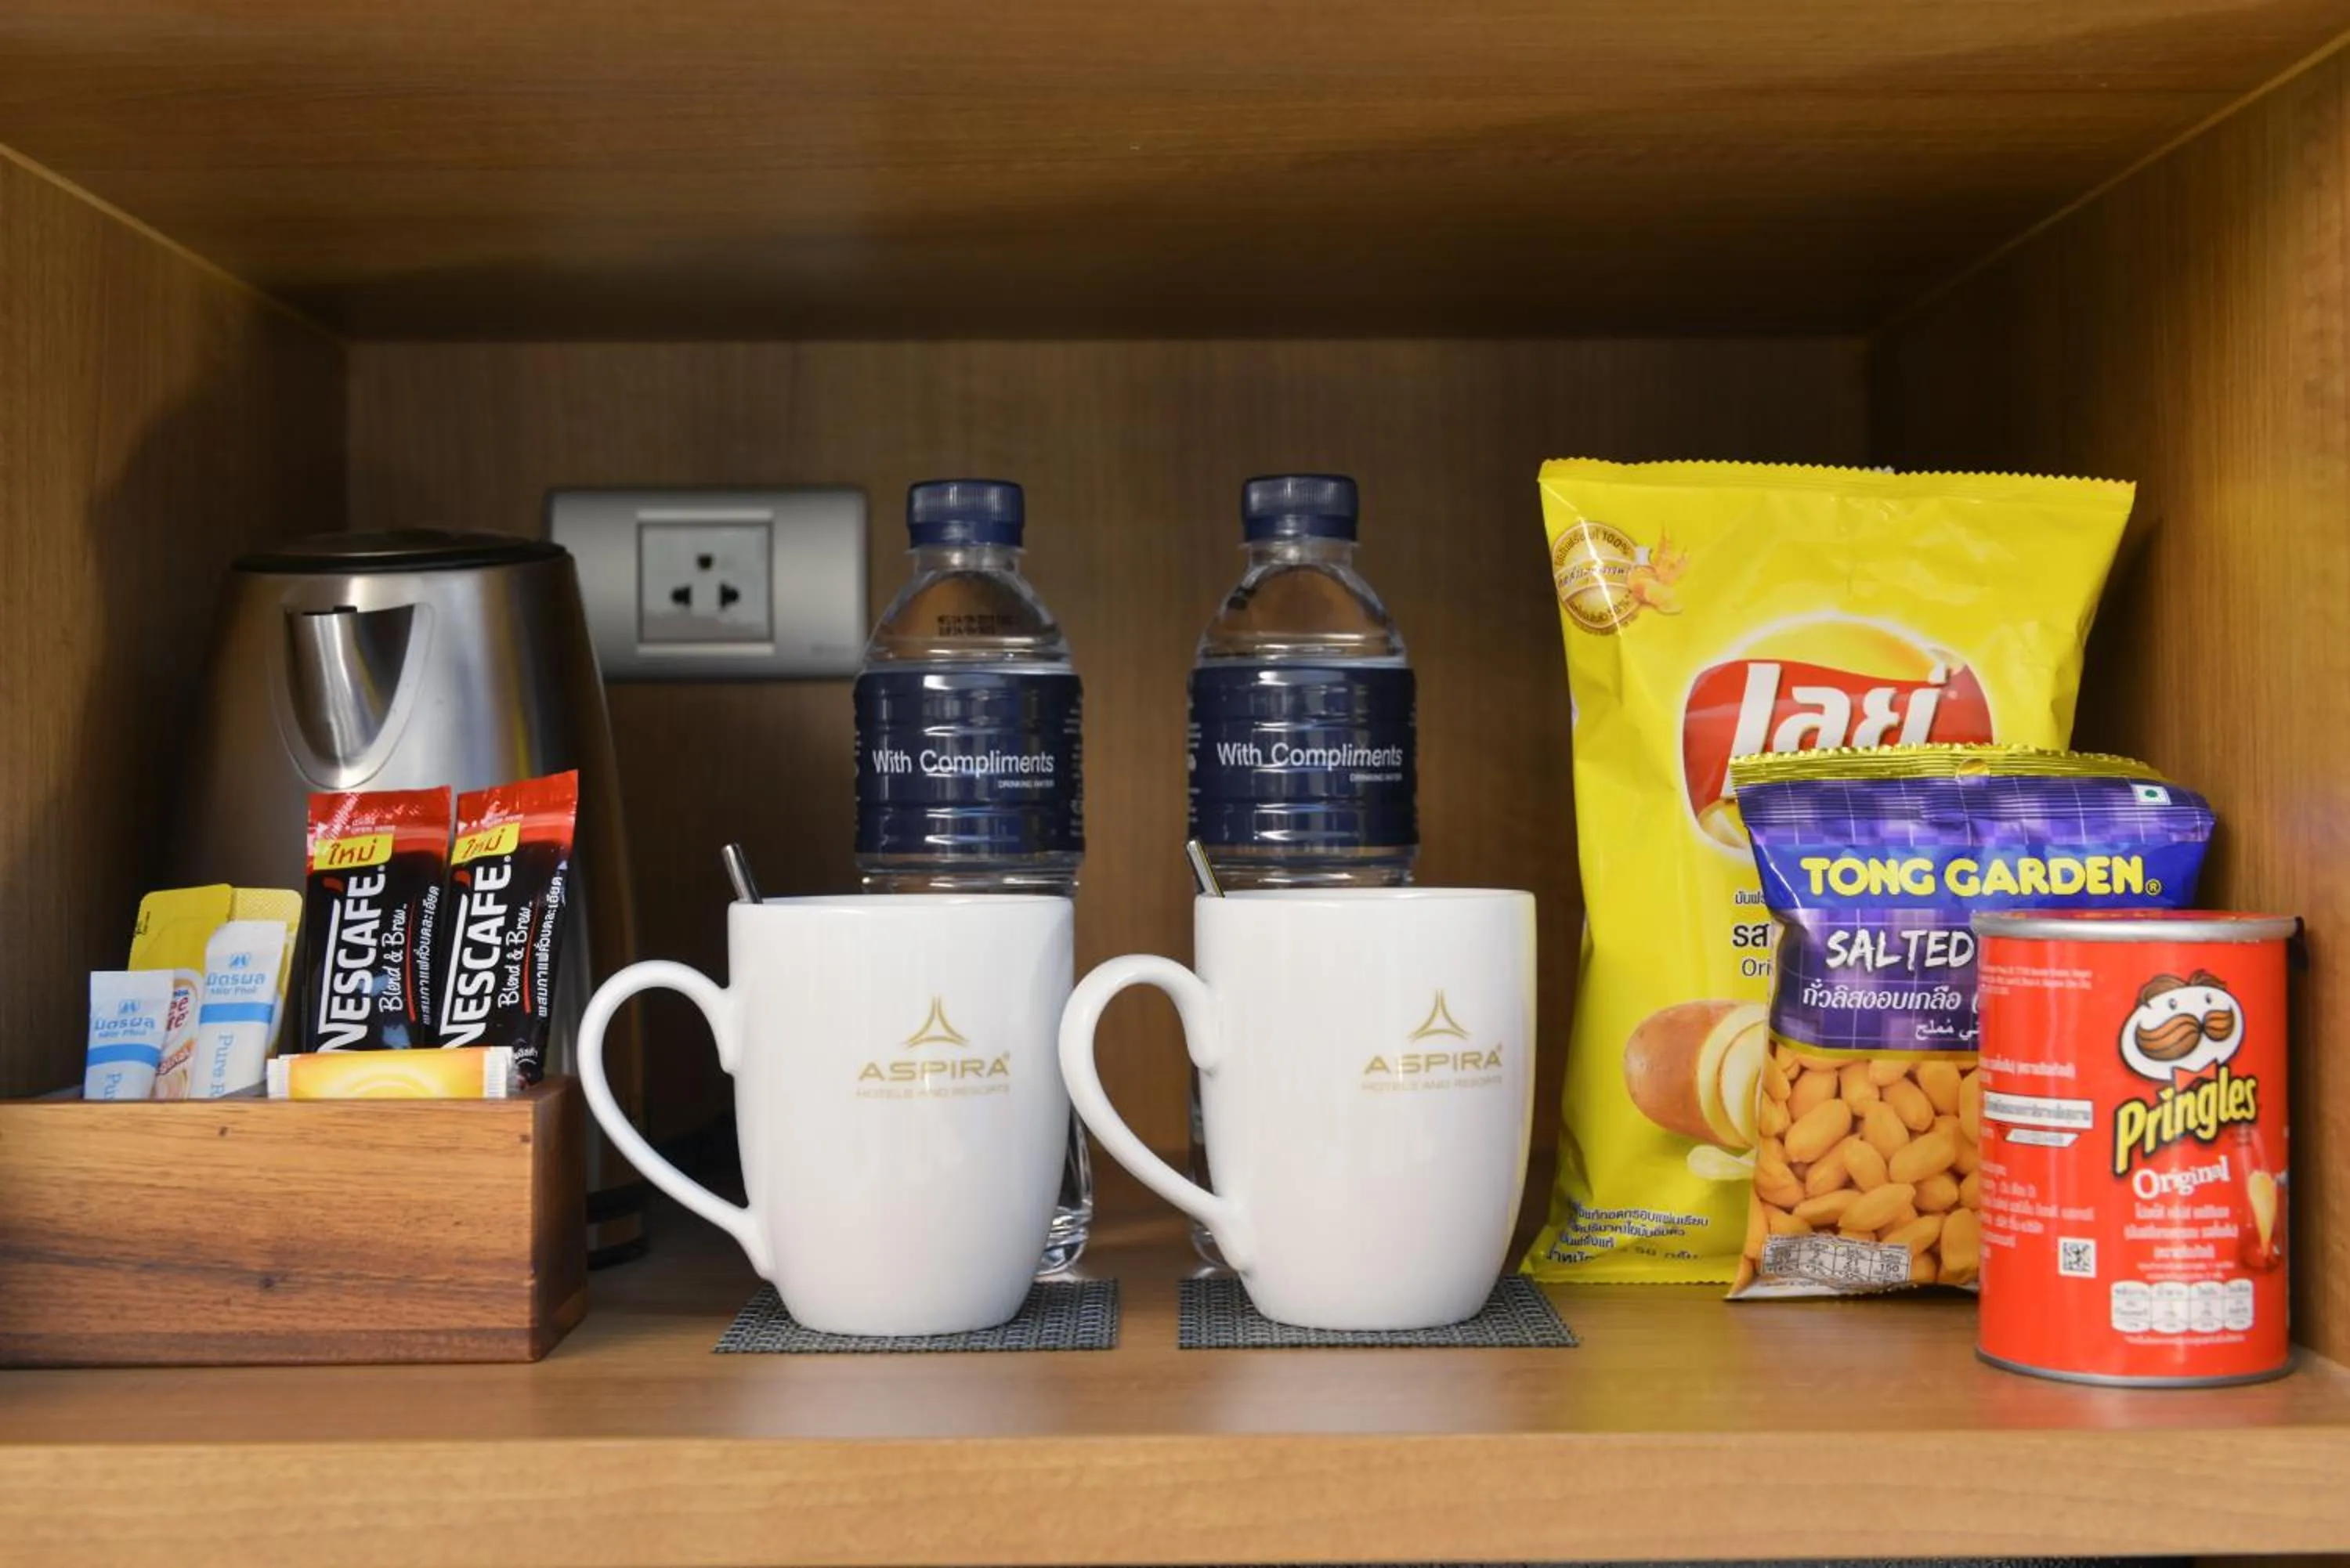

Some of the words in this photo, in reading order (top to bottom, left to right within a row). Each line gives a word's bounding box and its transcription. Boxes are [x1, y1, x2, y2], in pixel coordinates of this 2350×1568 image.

[873, 750, 912, 773] With
[920, 749, 1054, 779] Compliments
[1217, 742, 1262, 766] With
[1271, 742, 1403, 771] Compliments
[328, 838, 377, 865] ใหม่
[1801, 857, 1936, 897] TONG
[1945, 856, 2146, 897] GARDEN
[1732, 923, 1770, 948] รส
[1825, 927, 1976, 973] SALTED
[383, 949, 403, 963] &
[506, 946, 524, 962] &
[1741, 958, 1770, 977] Ori
[379, 965, 403, 1013] Blend
[497, 964, 519, 1008] Blend
[213, 1034, 234, 1078] Pure
[858, 1058, 1010, 1082] ASPIRA
[1364, 1050, 1502, 1075] ASPIRA
[104, 1072, 122, 1099] Pu
[2115, 1066, 2258, 1176] Pringles
[2132, 1154, 2231, 1200] Original
